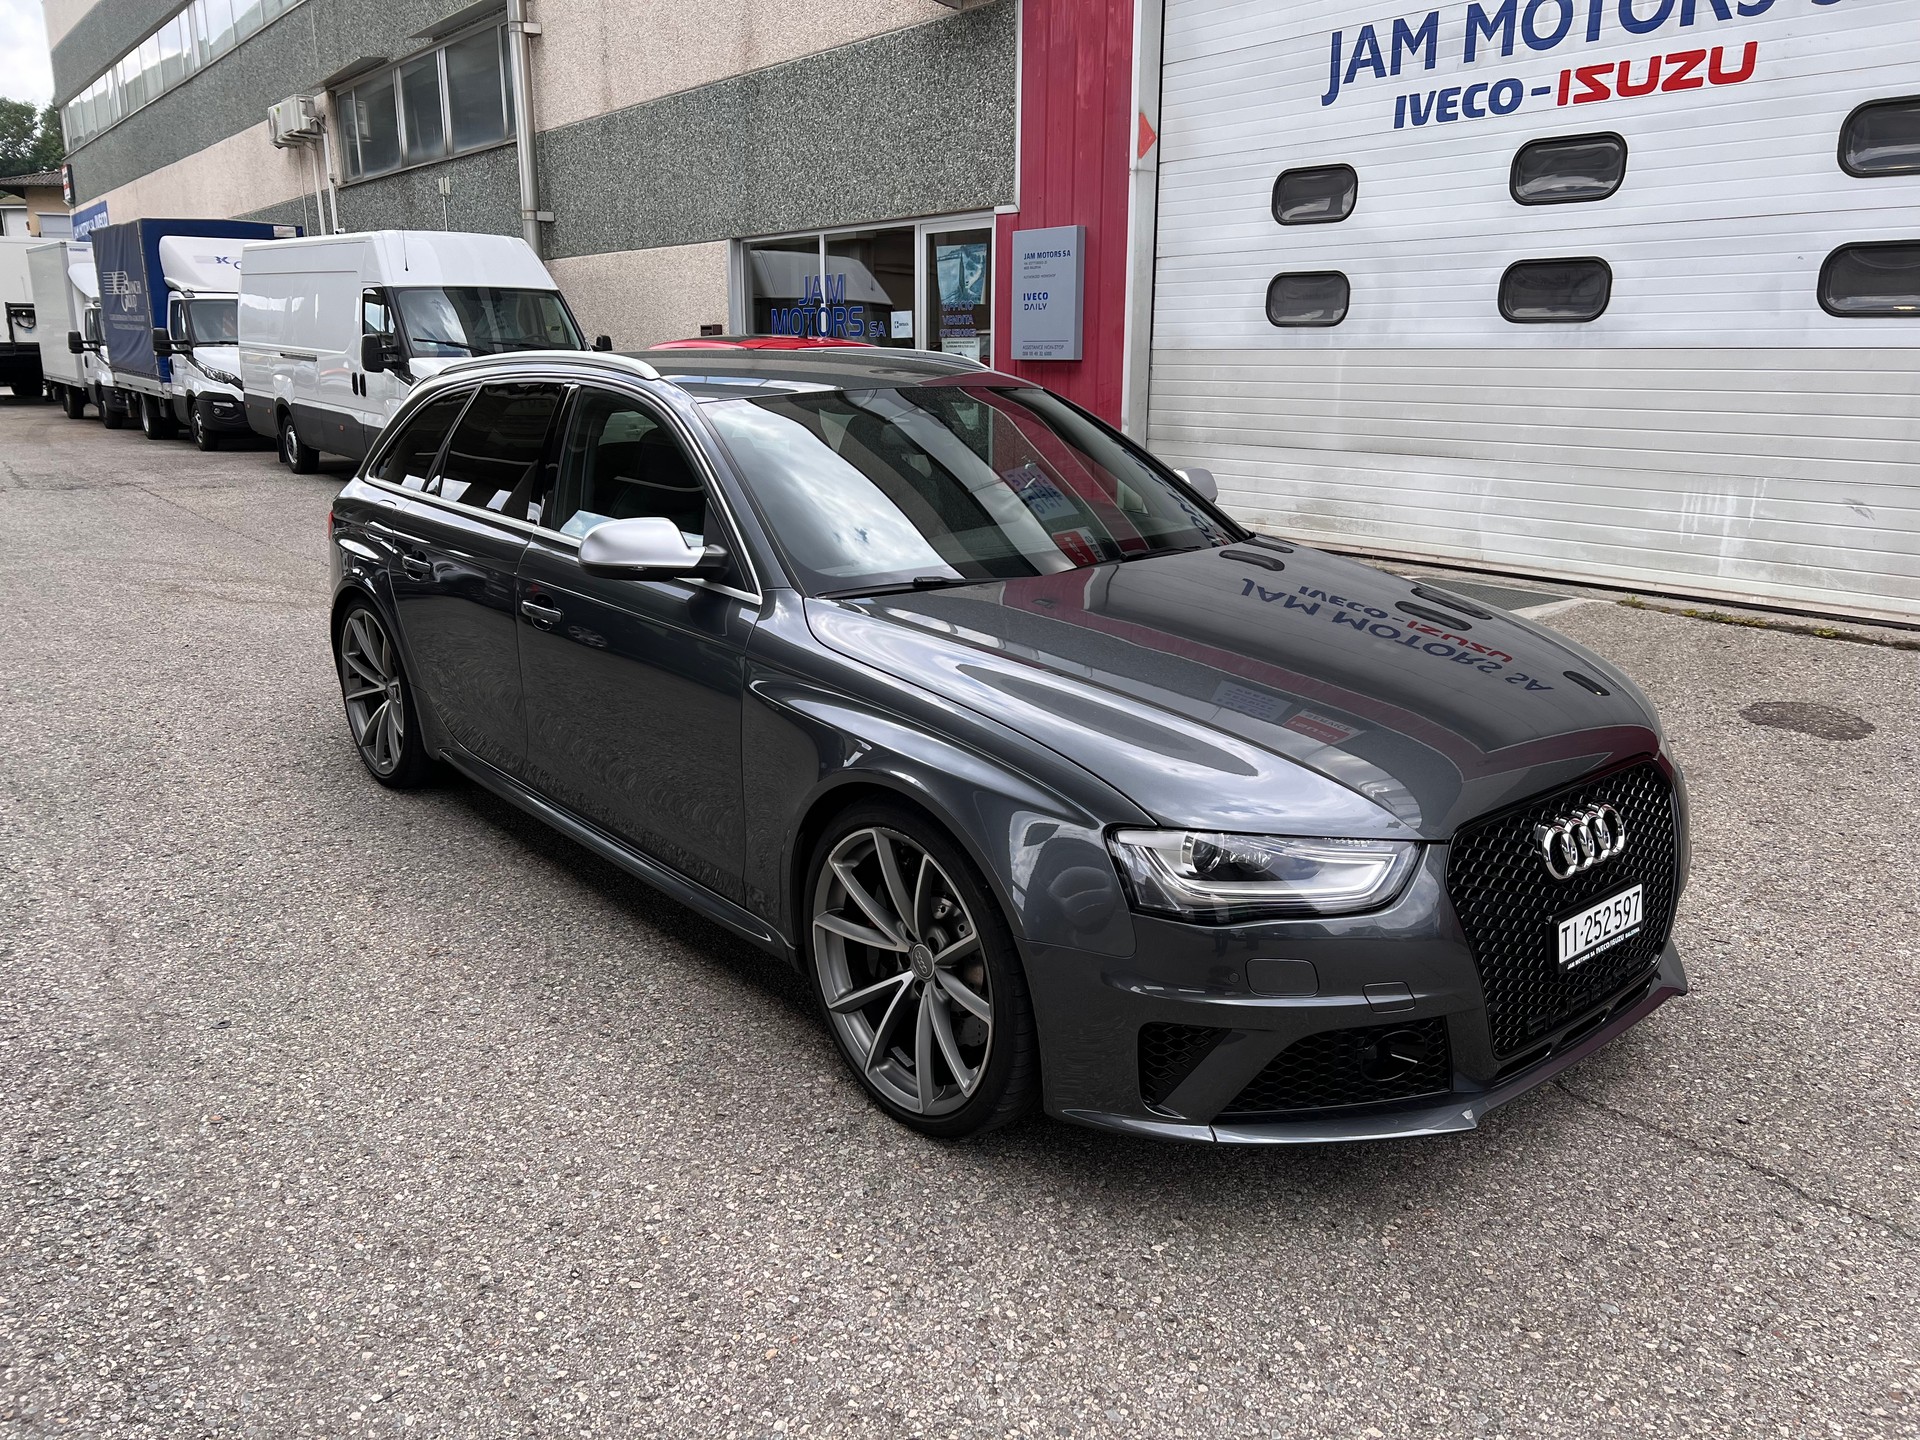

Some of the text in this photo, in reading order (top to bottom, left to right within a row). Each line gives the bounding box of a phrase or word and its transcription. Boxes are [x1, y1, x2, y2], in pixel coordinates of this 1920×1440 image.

[1321, 0, 1776, 107] JAM MOTO
[1023, 249, 1071, 260] JAM MOTORS SA
[798, 273, 846, 305] JAM
[1023, 292, 1048, 301] IVECO
[771, 306, 887, 337] MOTORS SA
